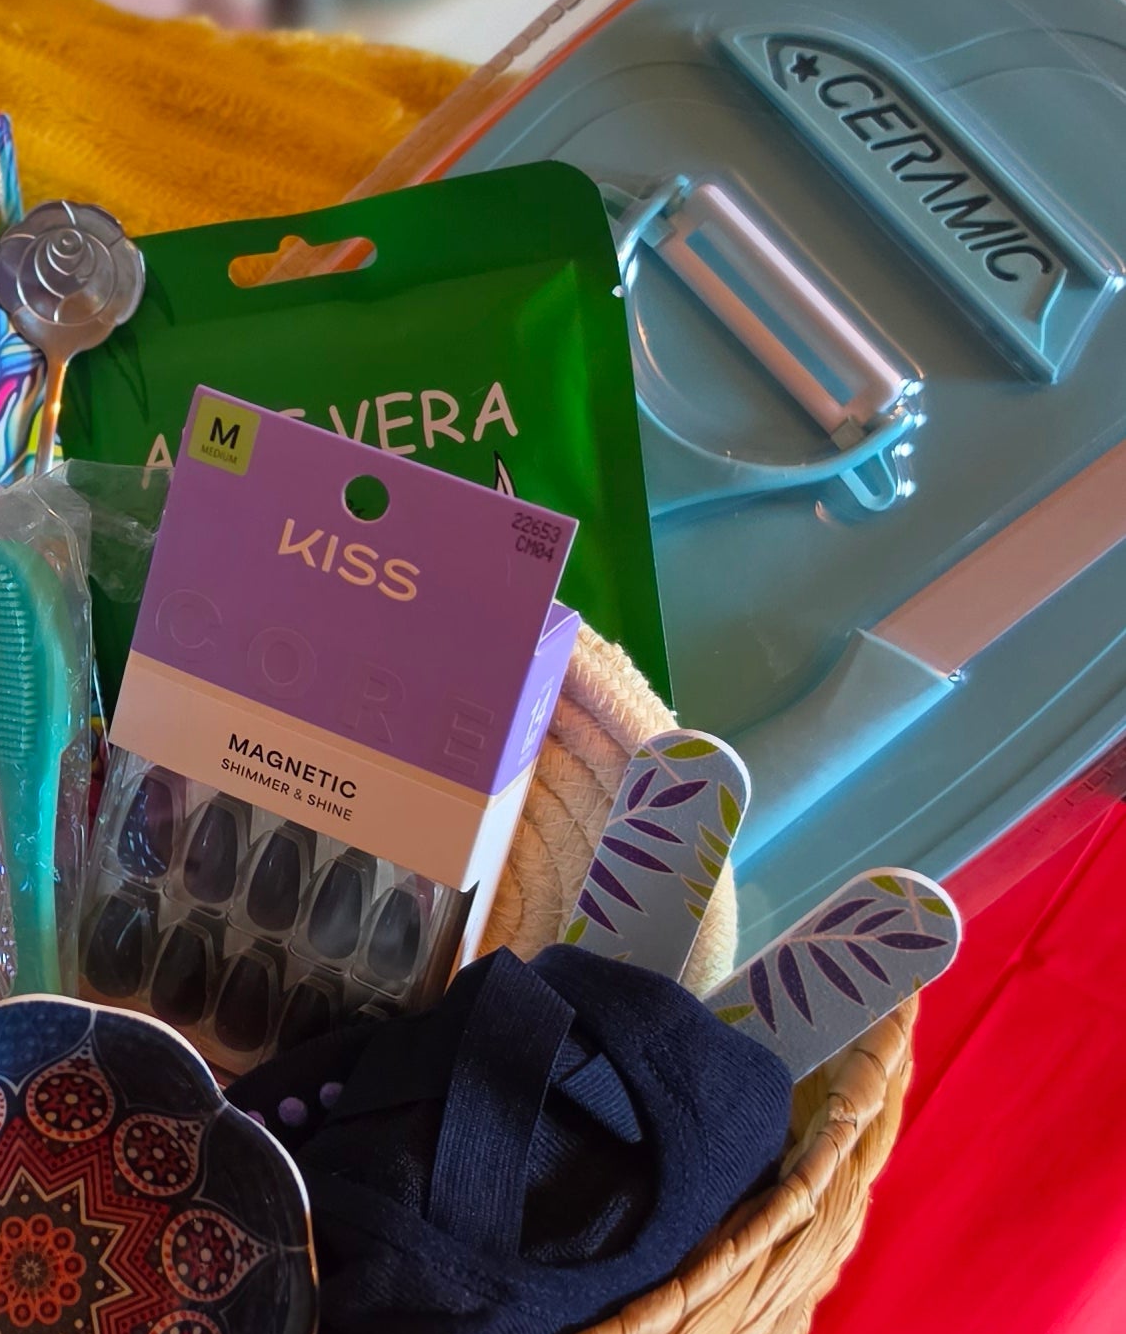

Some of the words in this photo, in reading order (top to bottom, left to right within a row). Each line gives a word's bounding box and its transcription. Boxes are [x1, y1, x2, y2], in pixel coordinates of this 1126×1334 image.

[817, 72, 1053, 283] CERAMIC
[209, 417, 241, 449] M
[329, 381, 519, 455] VERA
[200, 443, 238, 465] MEDIUM
[278, 518, 421, 602] KISS
[511, 512, 562, 544] 22653
[515, 534, 555, 563] CM04
[155, 588, 497, 776] CORE
[221, 758, 290, 796] SHIMMER
[293, 788, 303, 802] &
[307, 794, 353, 822] SHINE
[228, 733, 357, 799] MAGNETIC
